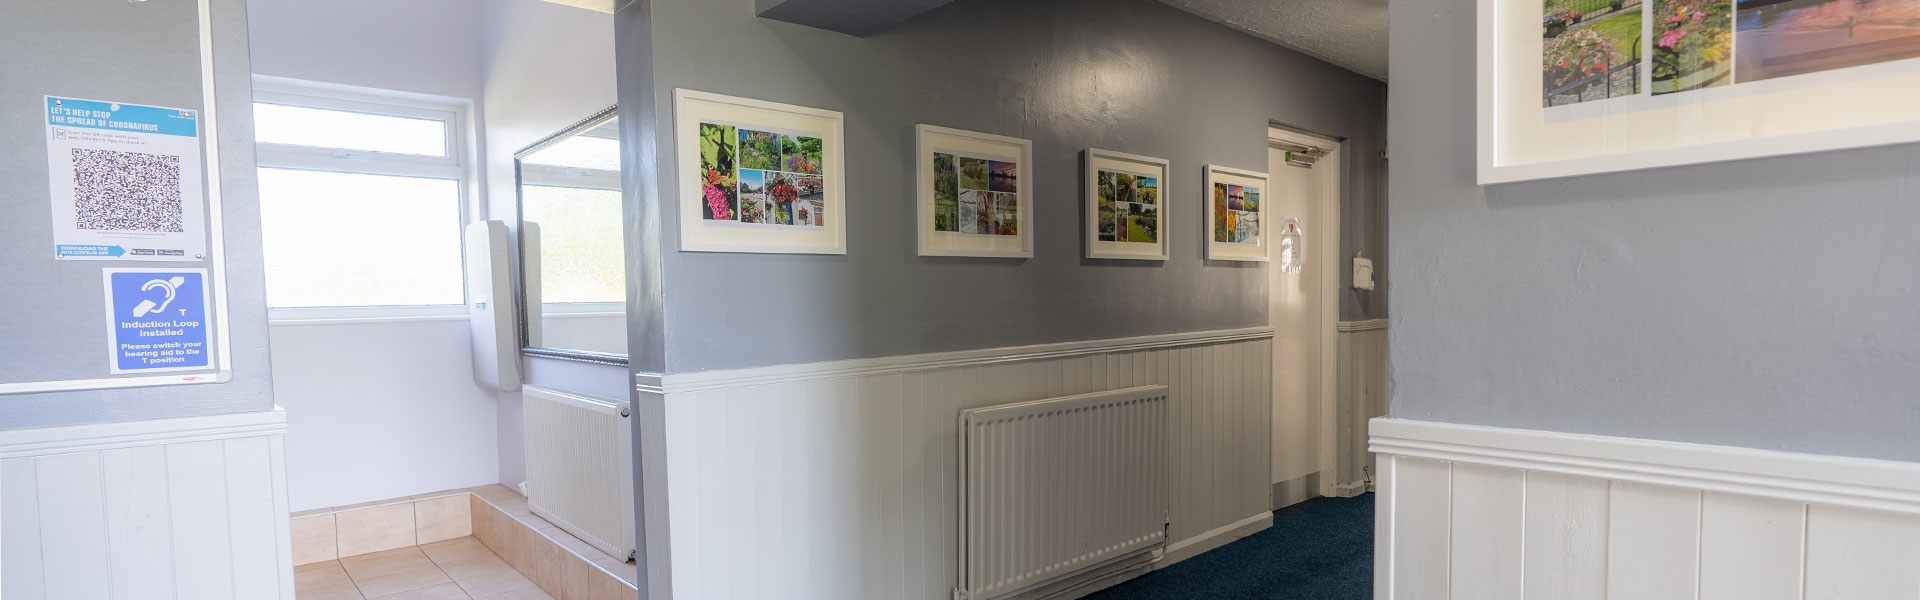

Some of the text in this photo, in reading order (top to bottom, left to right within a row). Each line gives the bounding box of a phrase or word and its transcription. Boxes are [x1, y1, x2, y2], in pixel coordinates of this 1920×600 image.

[50, 106, 111, 119] LET'S HELP STOP
[68, 117, 96, 126] SPREAD
[108, 120, 158, 132] CORONAVIRUS
[178, 308, 186, 316] T
[122, 320, 170, 328] Induction
